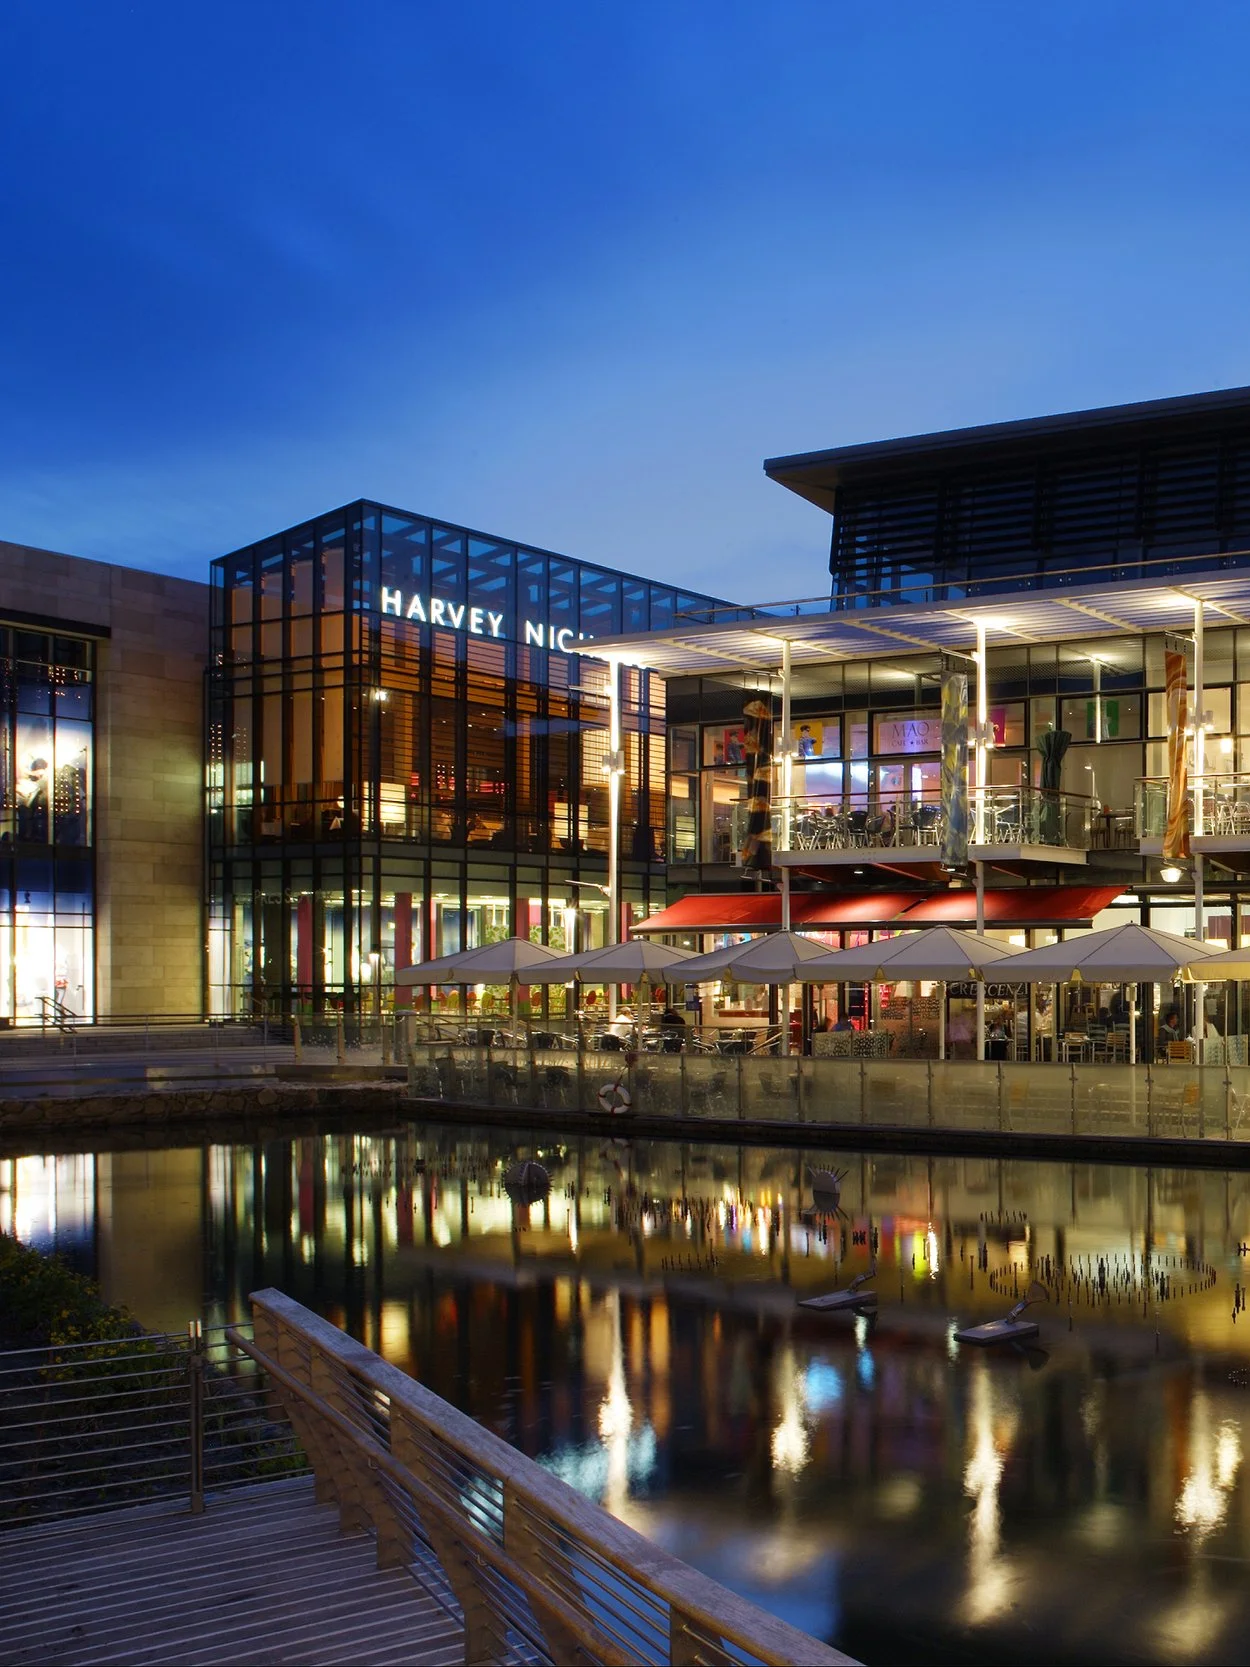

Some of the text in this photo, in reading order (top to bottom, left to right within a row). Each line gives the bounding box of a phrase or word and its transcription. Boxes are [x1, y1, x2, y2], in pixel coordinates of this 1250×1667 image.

[381, 586, 594, 654] HARVEY NIC
[892, 721, 930, 738] MAO
